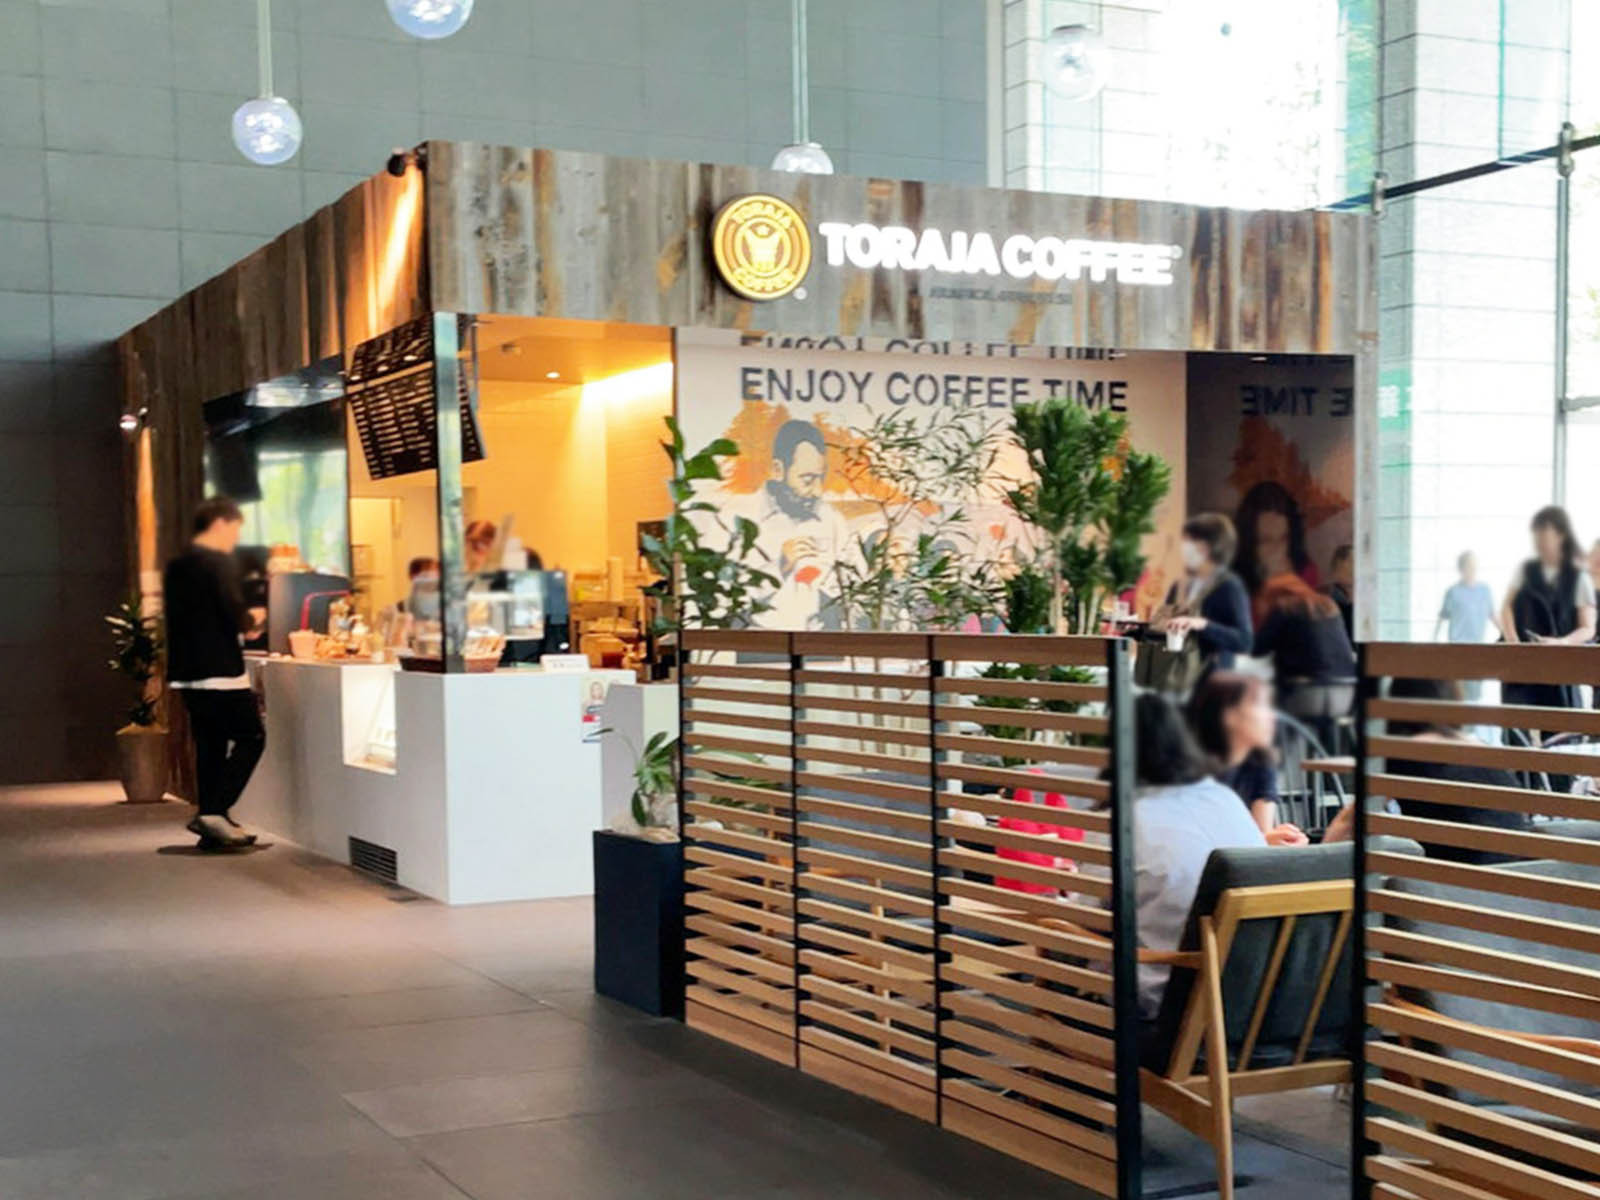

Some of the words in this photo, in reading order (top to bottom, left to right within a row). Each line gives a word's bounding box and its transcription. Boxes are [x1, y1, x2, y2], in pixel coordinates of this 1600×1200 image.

[819, 222, 1001, 275] TORAJA
[1002, 234, 1174, 285] COFFEE
[740, 366, 873, 402] ENJOY
[885, 371, 1030, 410] COFFEE
[1042, 378, 1129, 413] TIME
